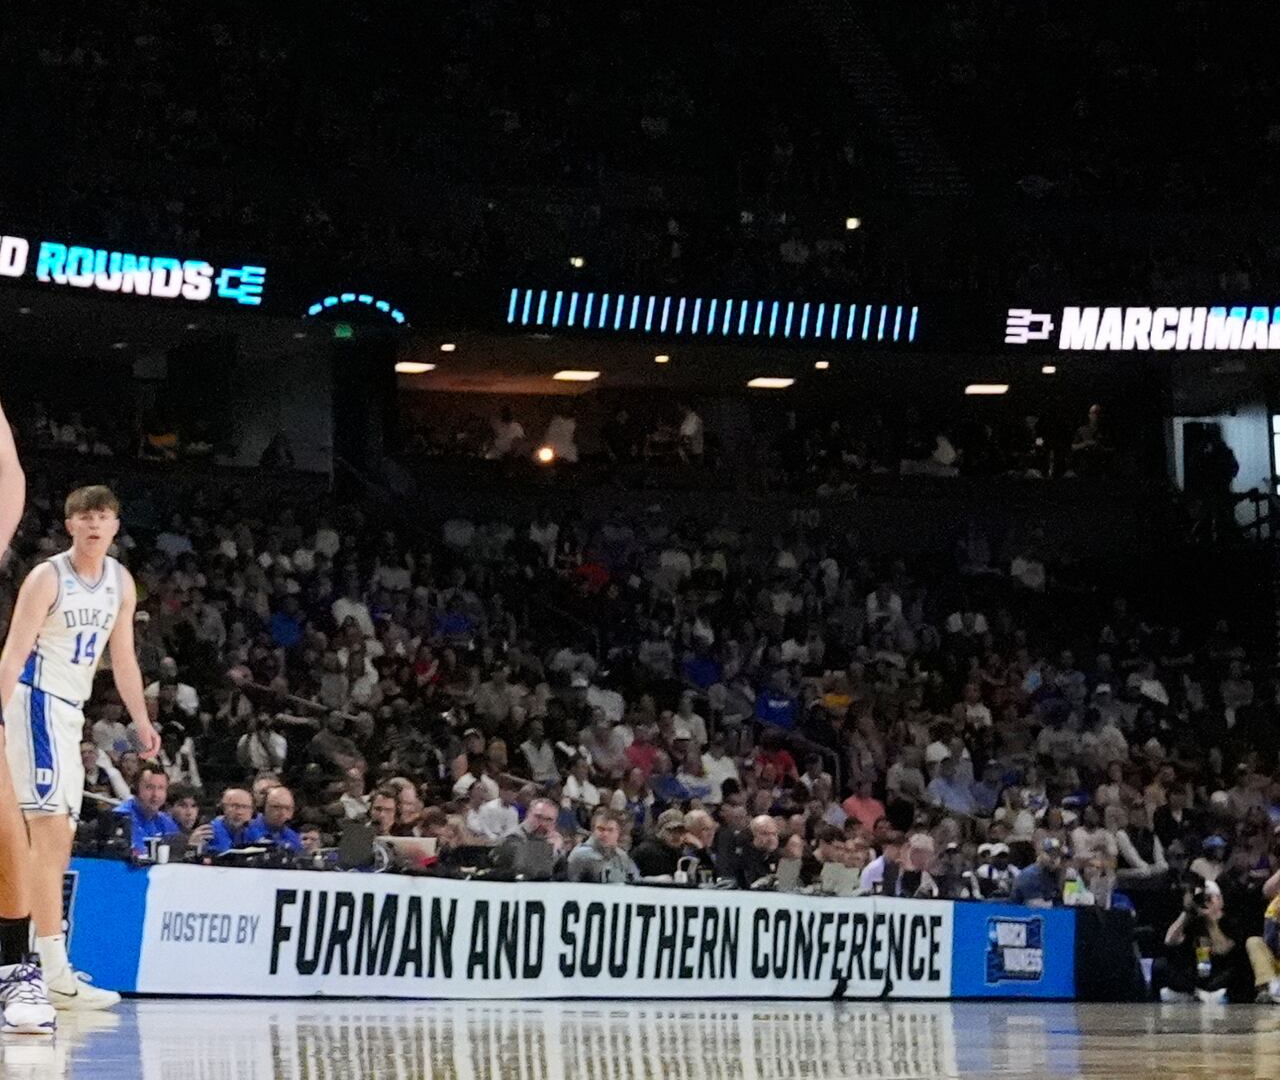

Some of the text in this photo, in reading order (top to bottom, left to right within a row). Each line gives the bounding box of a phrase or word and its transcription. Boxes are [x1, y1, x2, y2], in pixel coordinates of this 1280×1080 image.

[36, 241, 214, 302] ROUNDS
[1058, 306, 1280, 351] MARCHMA
[63, 607, 114, 631] DUKE
[70, 631, 99, 667] 14
[160, 888, 942, 982] HOSTED BY FURMAN AND SOUTHERN CONFERENCE
